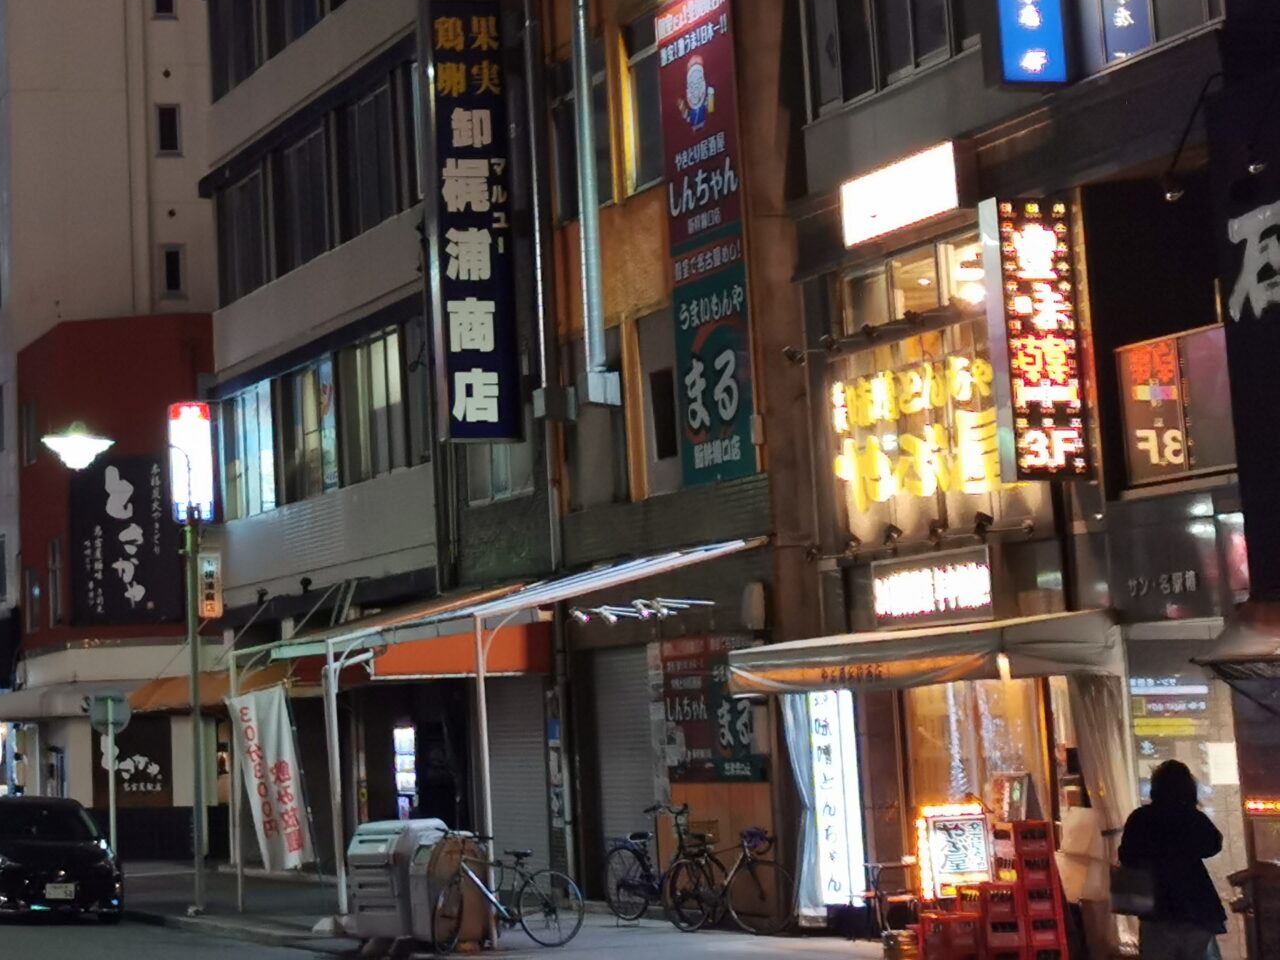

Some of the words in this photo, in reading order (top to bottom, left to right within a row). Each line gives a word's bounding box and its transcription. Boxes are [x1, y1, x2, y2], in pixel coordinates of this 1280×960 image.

[435, 16, 466, 97] 鶏卵
[470, 16, 501, 96] 果実
[491, 157, 509, 254] マルユー
[669, 156, 739, 217] しんちゃん
[679, 284, 744, 330] うまいもんや
[685, 349, 739, 430] まる
[1023, 431, 1078, 466] 3F
[105, 465, 146, 608] とさかや
[666, 693, 708, 721] しんちゃん
[717, 700, 754, 746] まる
